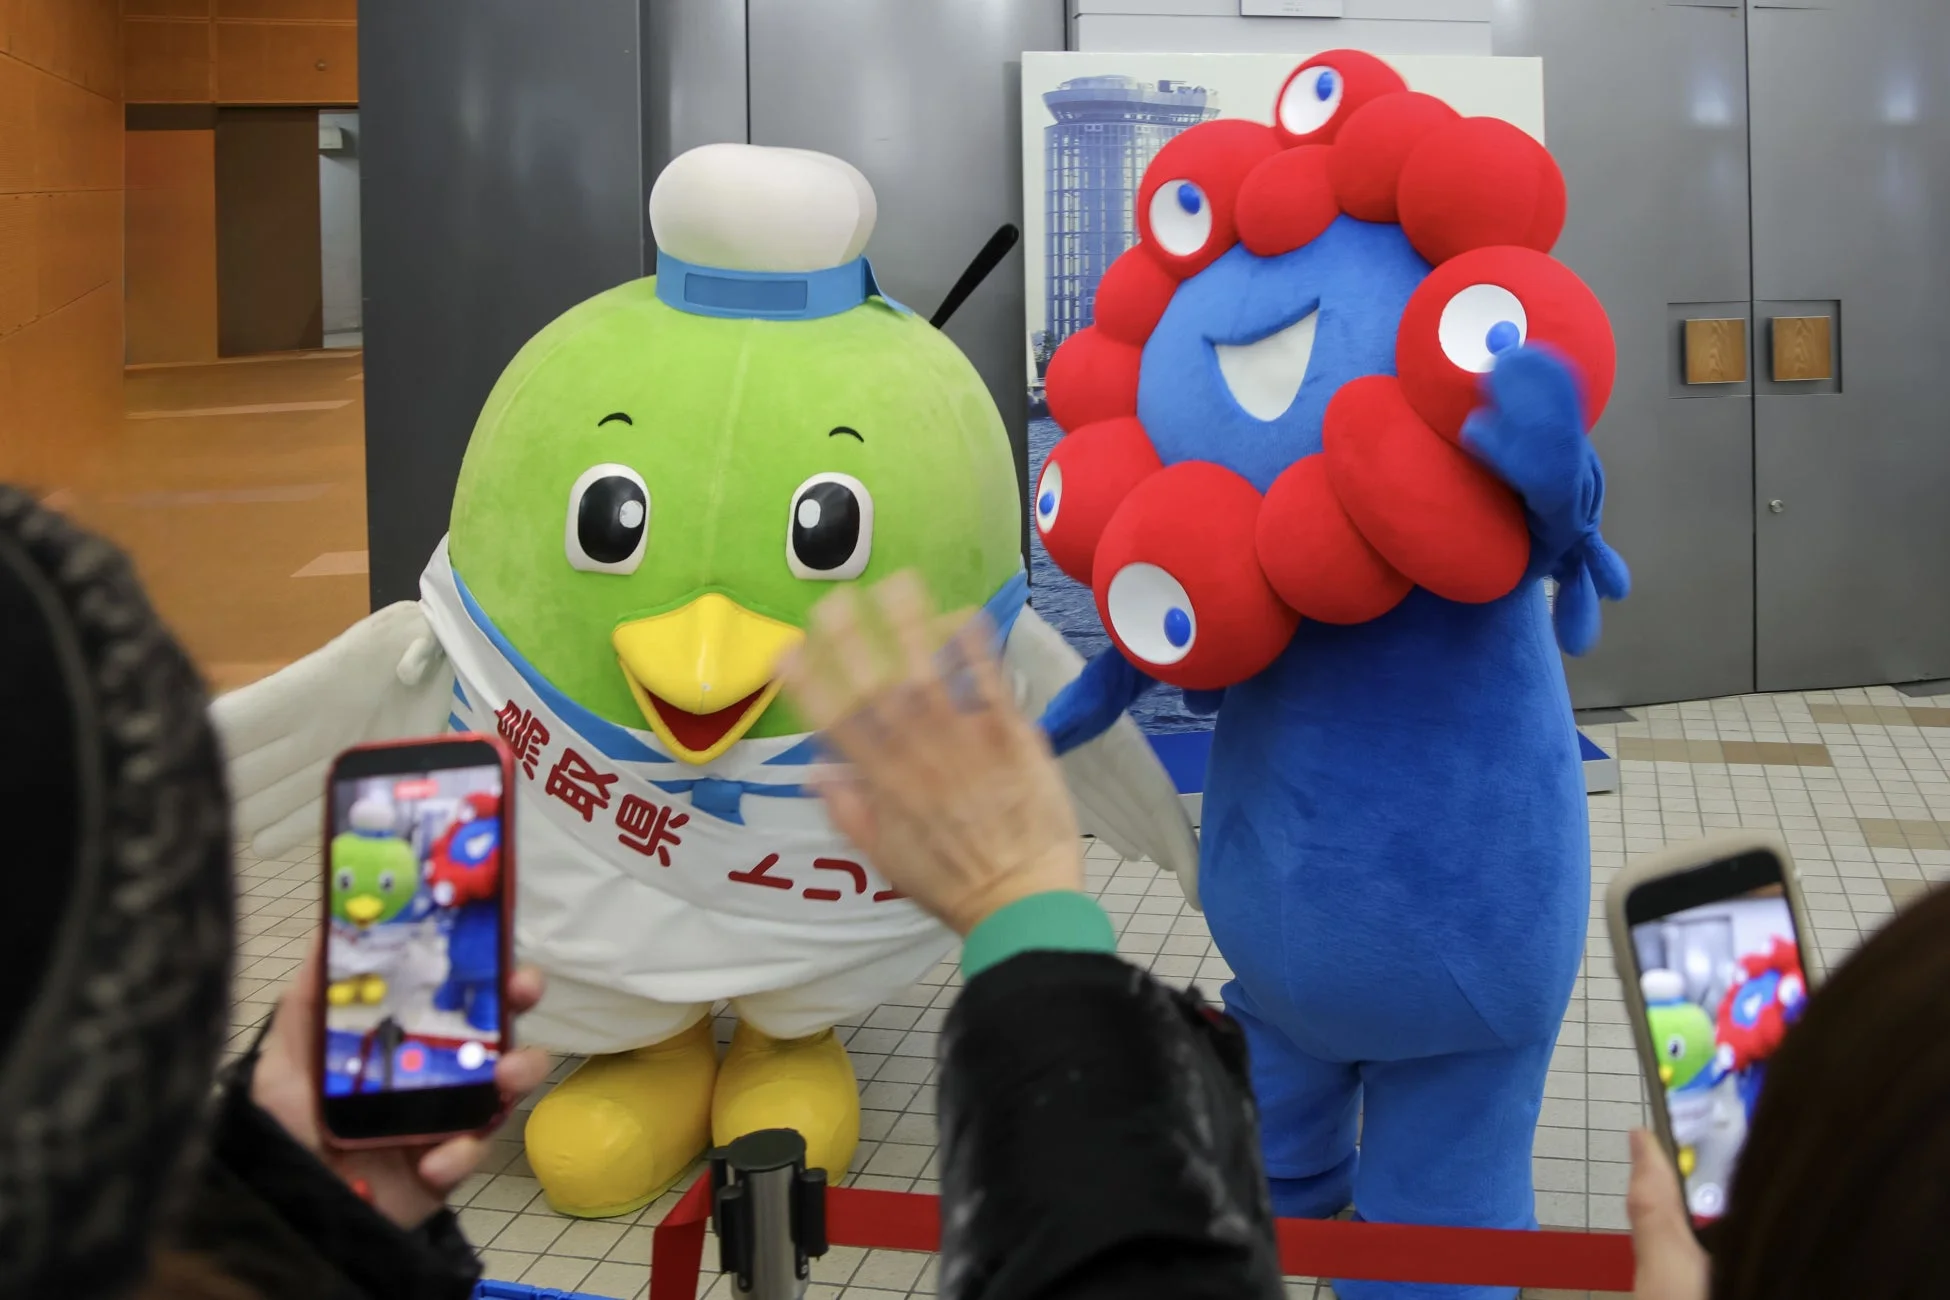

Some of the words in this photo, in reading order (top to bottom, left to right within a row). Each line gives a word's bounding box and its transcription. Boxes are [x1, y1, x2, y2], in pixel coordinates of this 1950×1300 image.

[494, 699, 690, 868] 鳥取県
[727, 852, 908, 903] トリ
